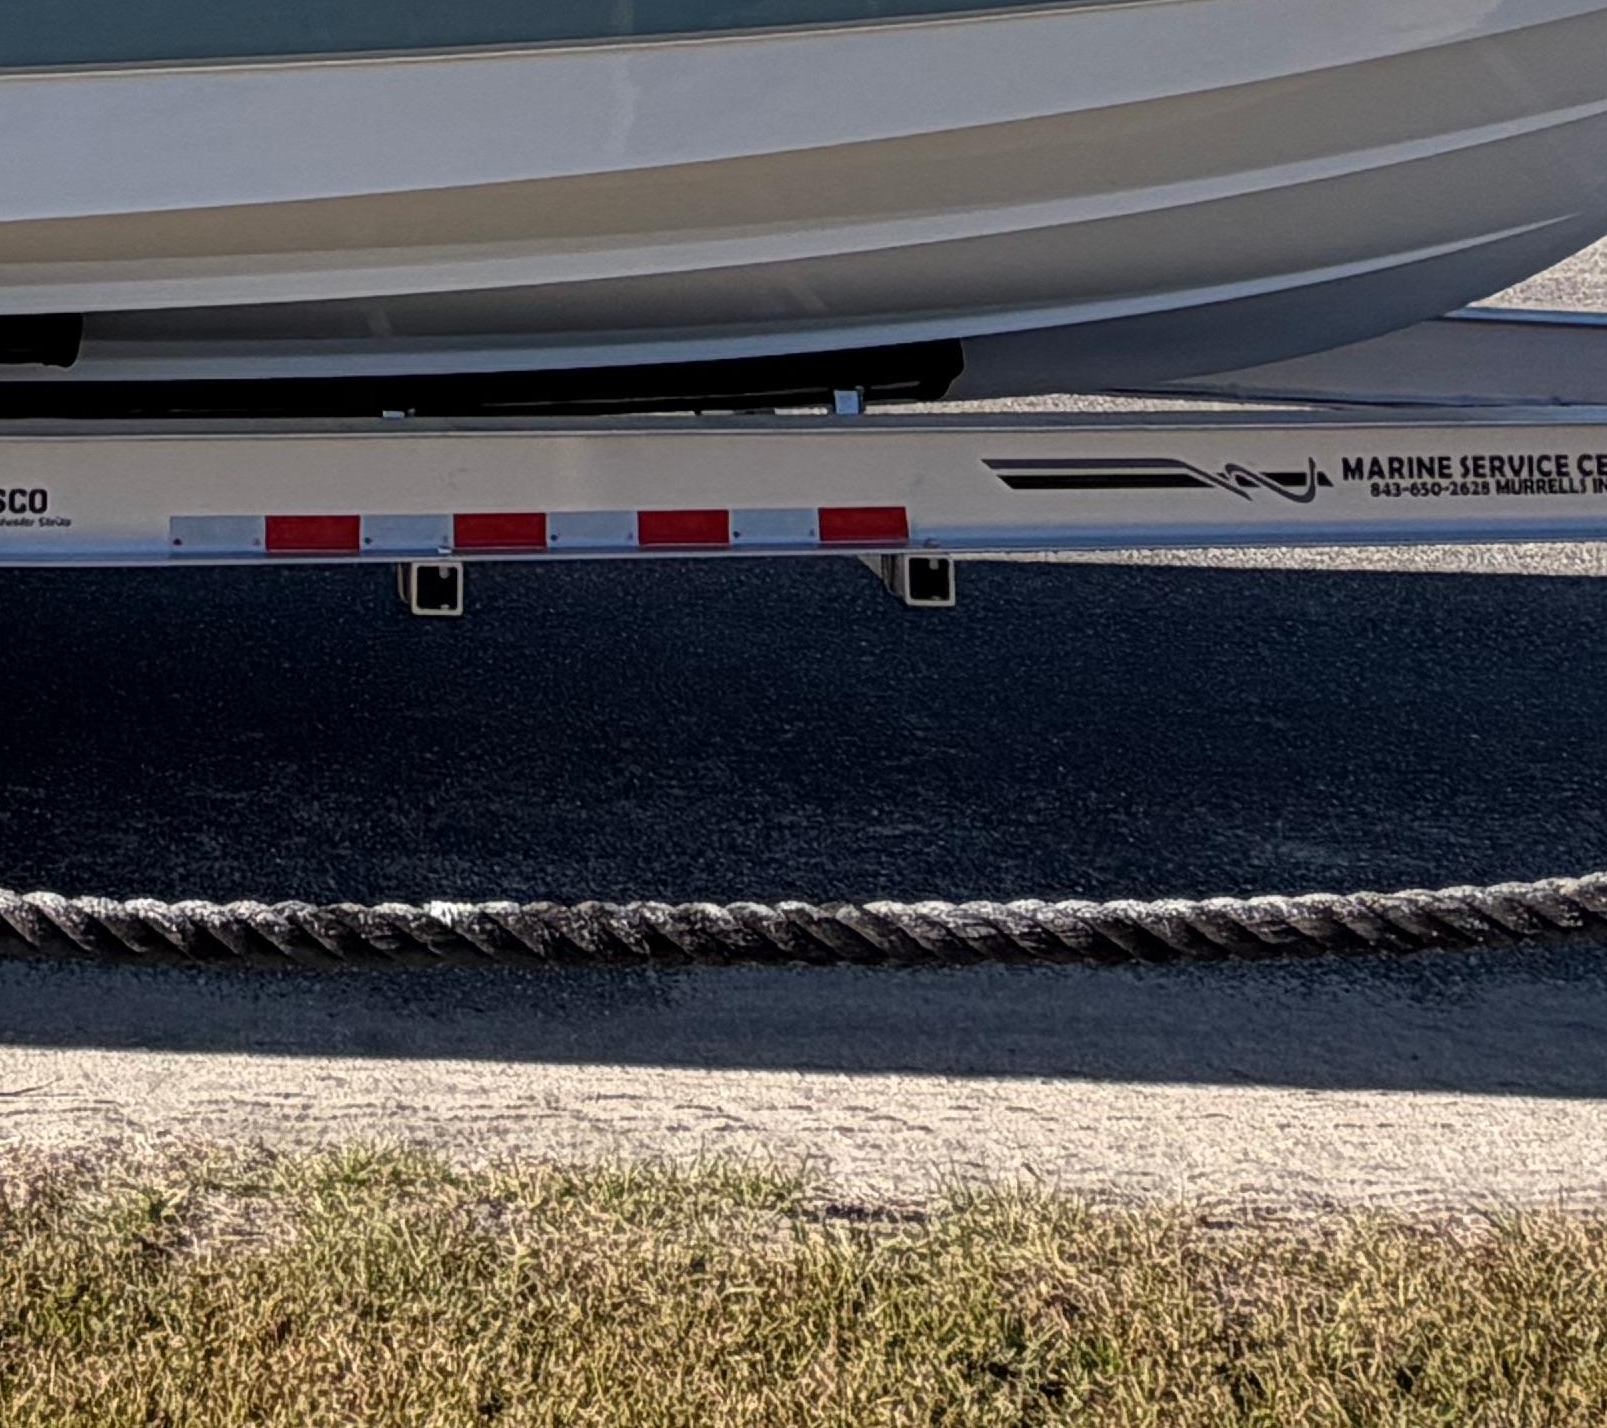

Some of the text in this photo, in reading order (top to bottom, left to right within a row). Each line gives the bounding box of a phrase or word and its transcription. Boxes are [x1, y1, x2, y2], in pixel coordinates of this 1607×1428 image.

[1341, 456, 1453, 481] MARINE
[1459, 454, 1570, 479] SERVICE
[1495, 477, 1587, 495] MURRELLS
